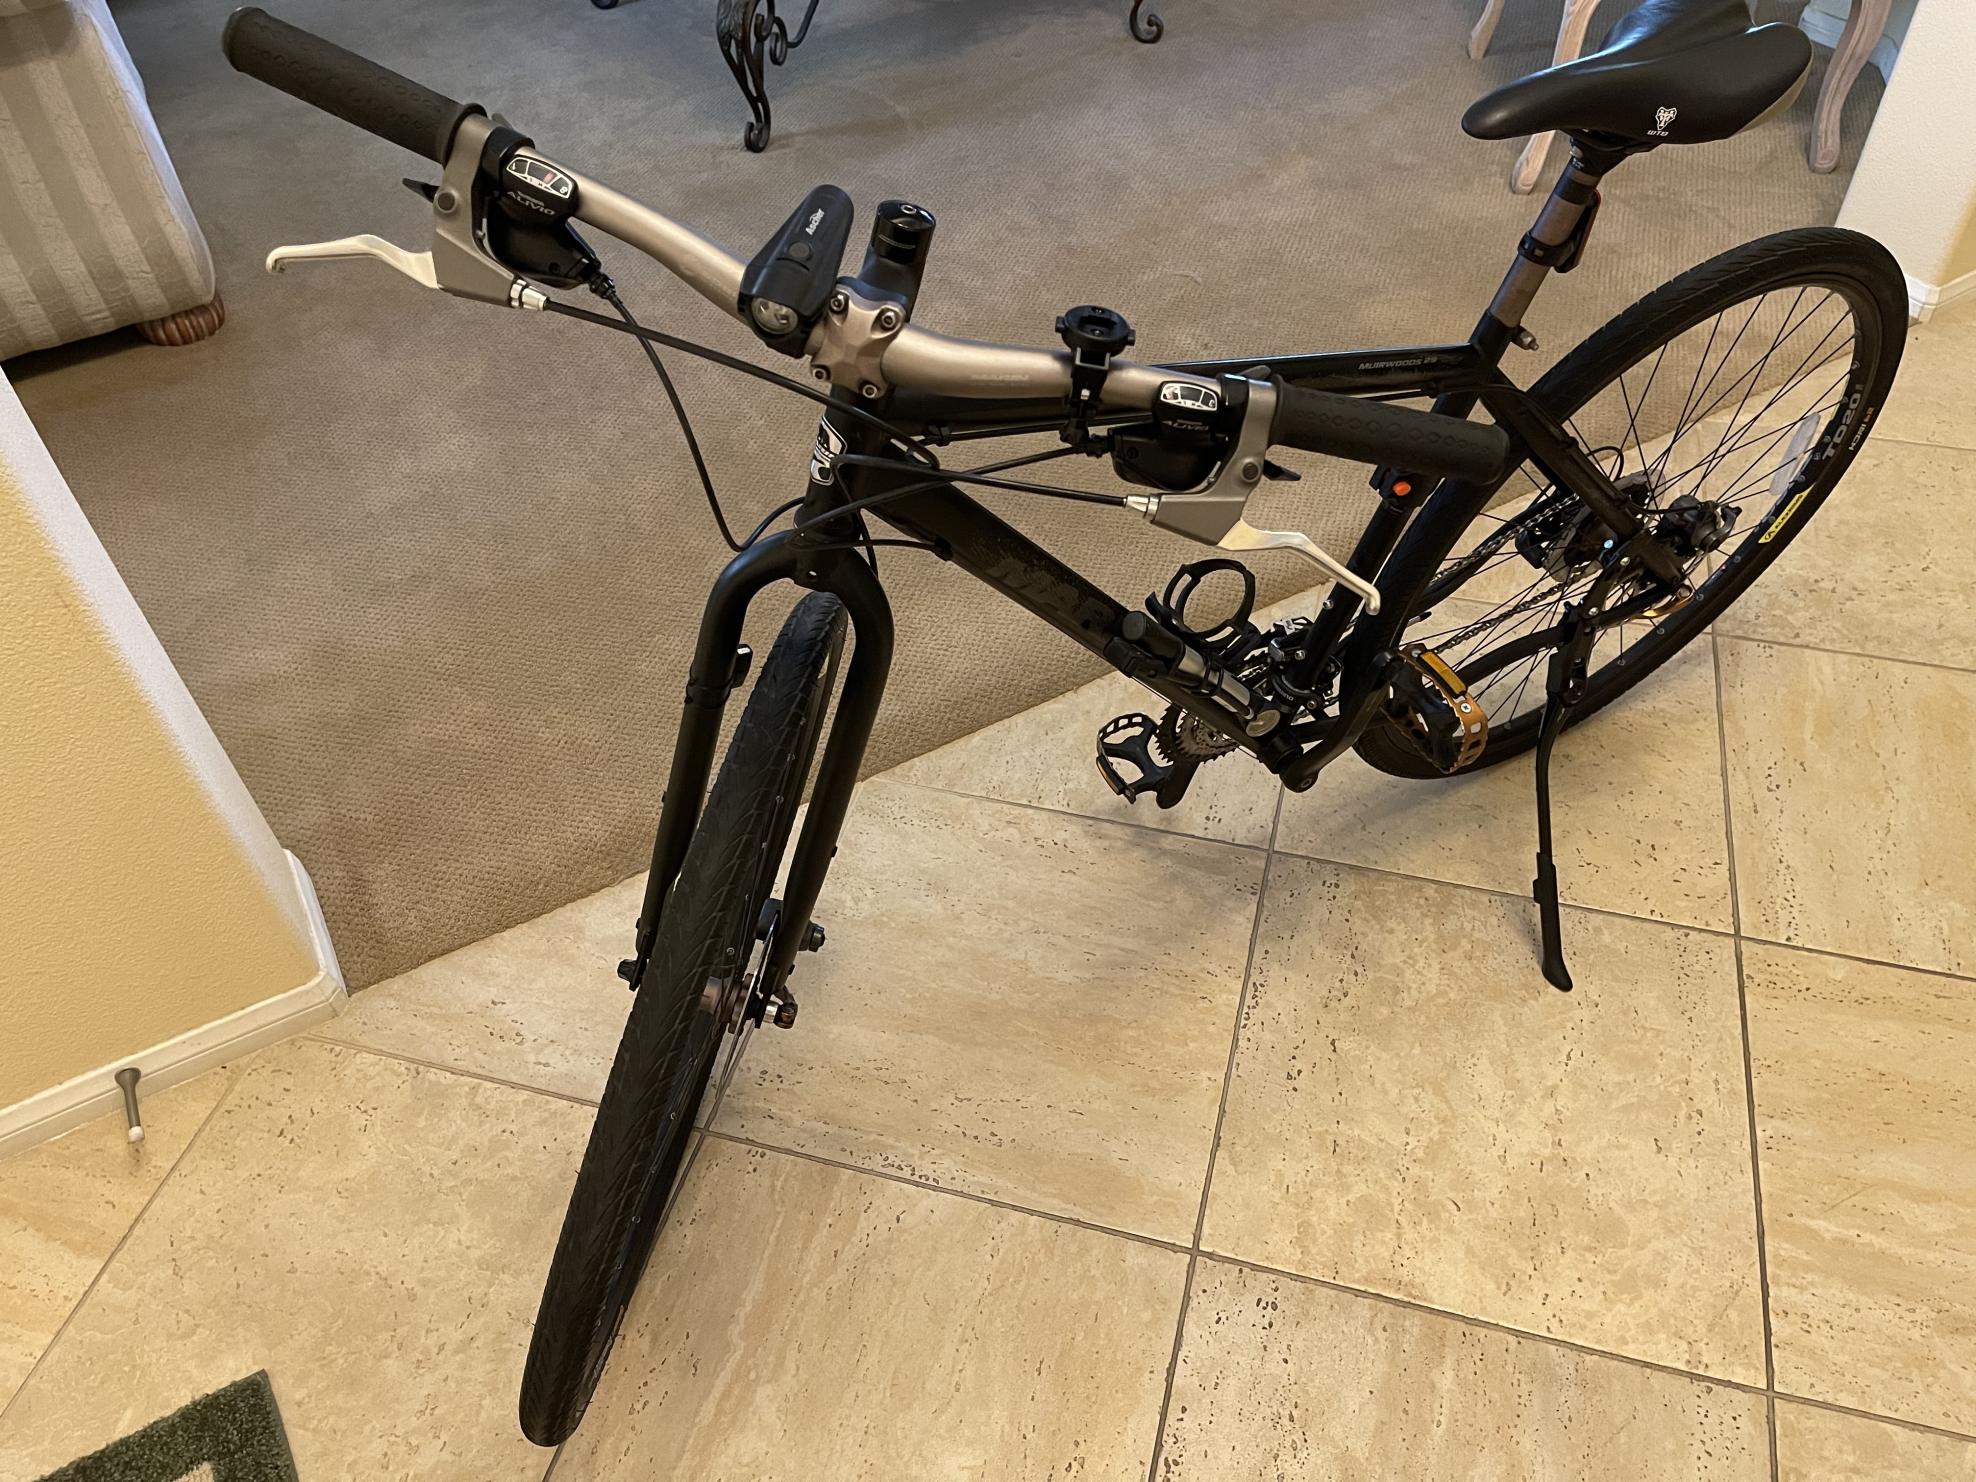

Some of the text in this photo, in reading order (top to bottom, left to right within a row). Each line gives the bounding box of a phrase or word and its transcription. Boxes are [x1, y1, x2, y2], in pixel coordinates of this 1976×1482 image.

[506, 190, 556, 216] ALIVIO
[805, 208, 825, 236] Ascher
[1358, 359, 1421, 370] MUIRWOODS
